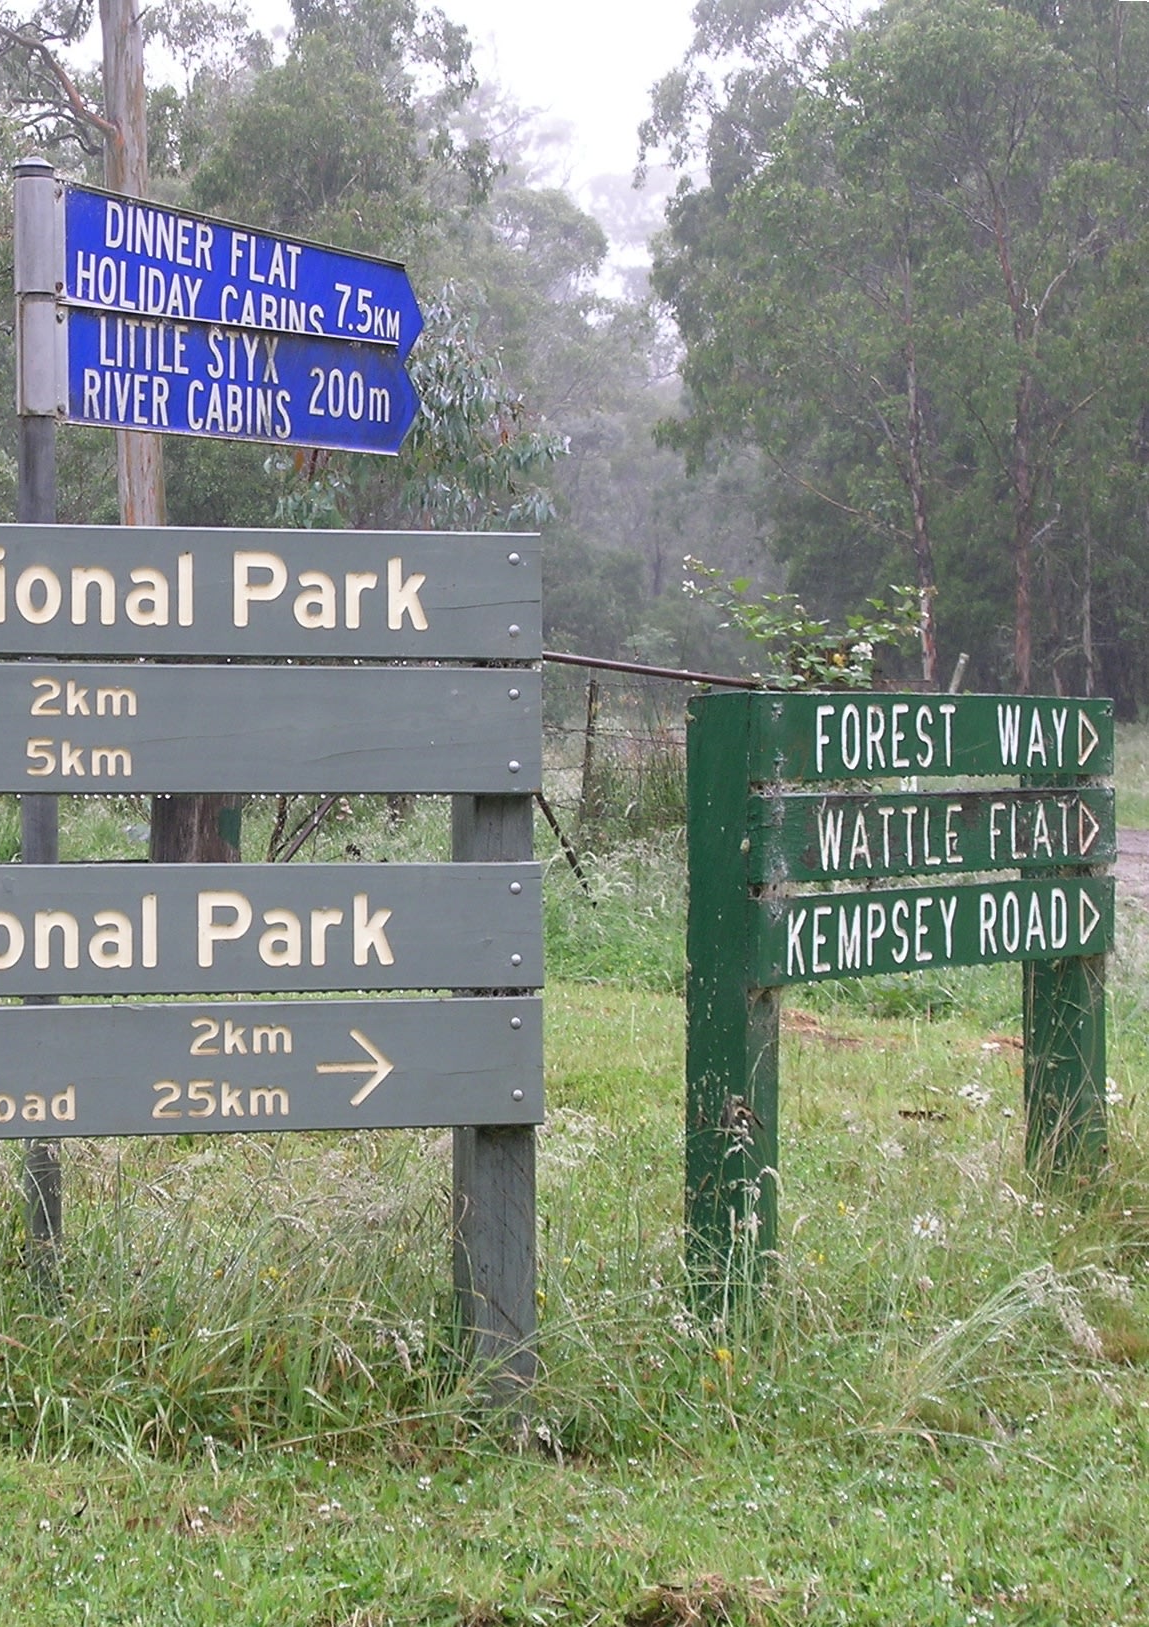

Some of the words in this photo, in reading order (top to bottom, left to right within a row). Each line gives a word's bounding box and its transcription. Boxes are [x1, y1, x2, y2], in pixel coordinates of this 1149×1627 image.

[105, 200, 214, 271] DINNER
[231, 231, 302, 290] FLAT
[76, 250, 202, 319] HOLIDAY
[220, 284, 325, 335] CABINS
[334, 282, 401, 341] 7.5KM
[99, 315, 190, 375] LITTLE
[207, 328, 280, 384] STYX
[83, 369, 169, 427] RIVER
[187, 382, 292, 440] CABINS
[309, 366, 391, 423] 200m
[233, 549, 429, 631] Park
[30, 676, 138, 717] 2km
[26, 737, 133, 777] 5km
[815, 703, 956, 773] FOREST
[997, 703, 1068, 769] WAY
[817, 804, 963, 871] WATTLE
[990, 799, 1074, 861] FLAT
[197, 890, 395, 969] Park
[786, 895, 958, 976] KEMPSEY
[979, 887, 1068, 957] ROAD
[190, 1016, 293, 1056] 2km
[152, 1079, 290, 1119] 25km
